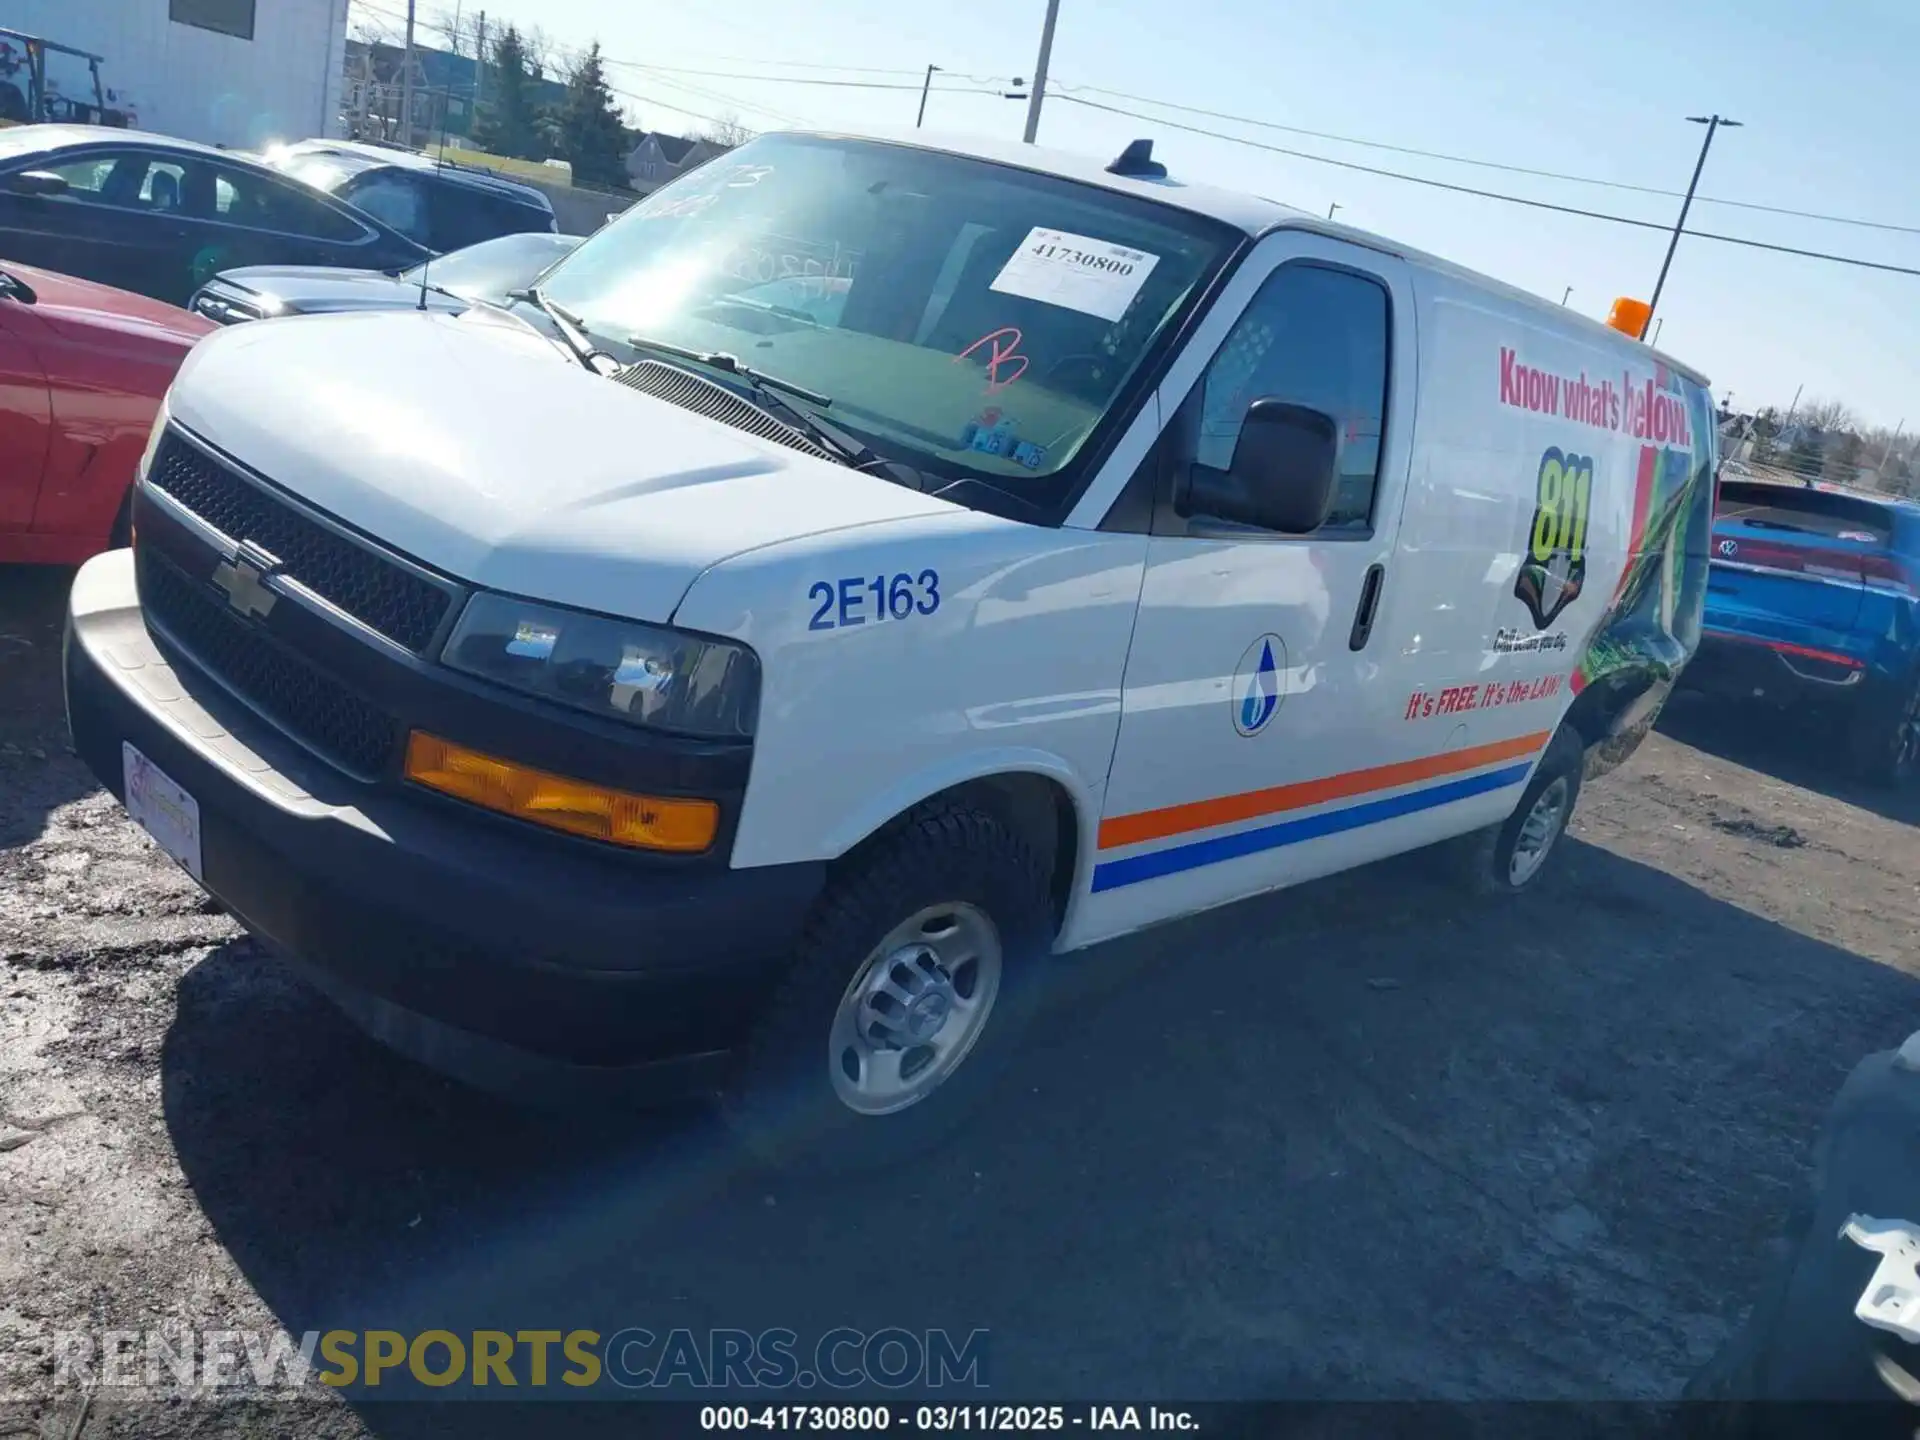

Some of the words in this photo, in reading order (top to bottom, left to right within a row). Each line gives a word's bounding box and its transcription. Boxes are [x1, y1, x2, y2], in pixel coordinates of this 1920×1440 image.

[1031, 243, 1134, 277] 41730800
[1500, 346, 1560, 416] Know
[1563, 370, 1619, 432] what's
[1622, 369, 1692, 447] below.
[1531, 451, 1592, 563] 811
[808, 568, 940, 631] 2E163
[1404, 692, 1434, 721] It's
[1436, 685, 1480, 716] FREE.
[1481, 682, 1506, 708] It's
[1507, 680, 1530, 704] the
